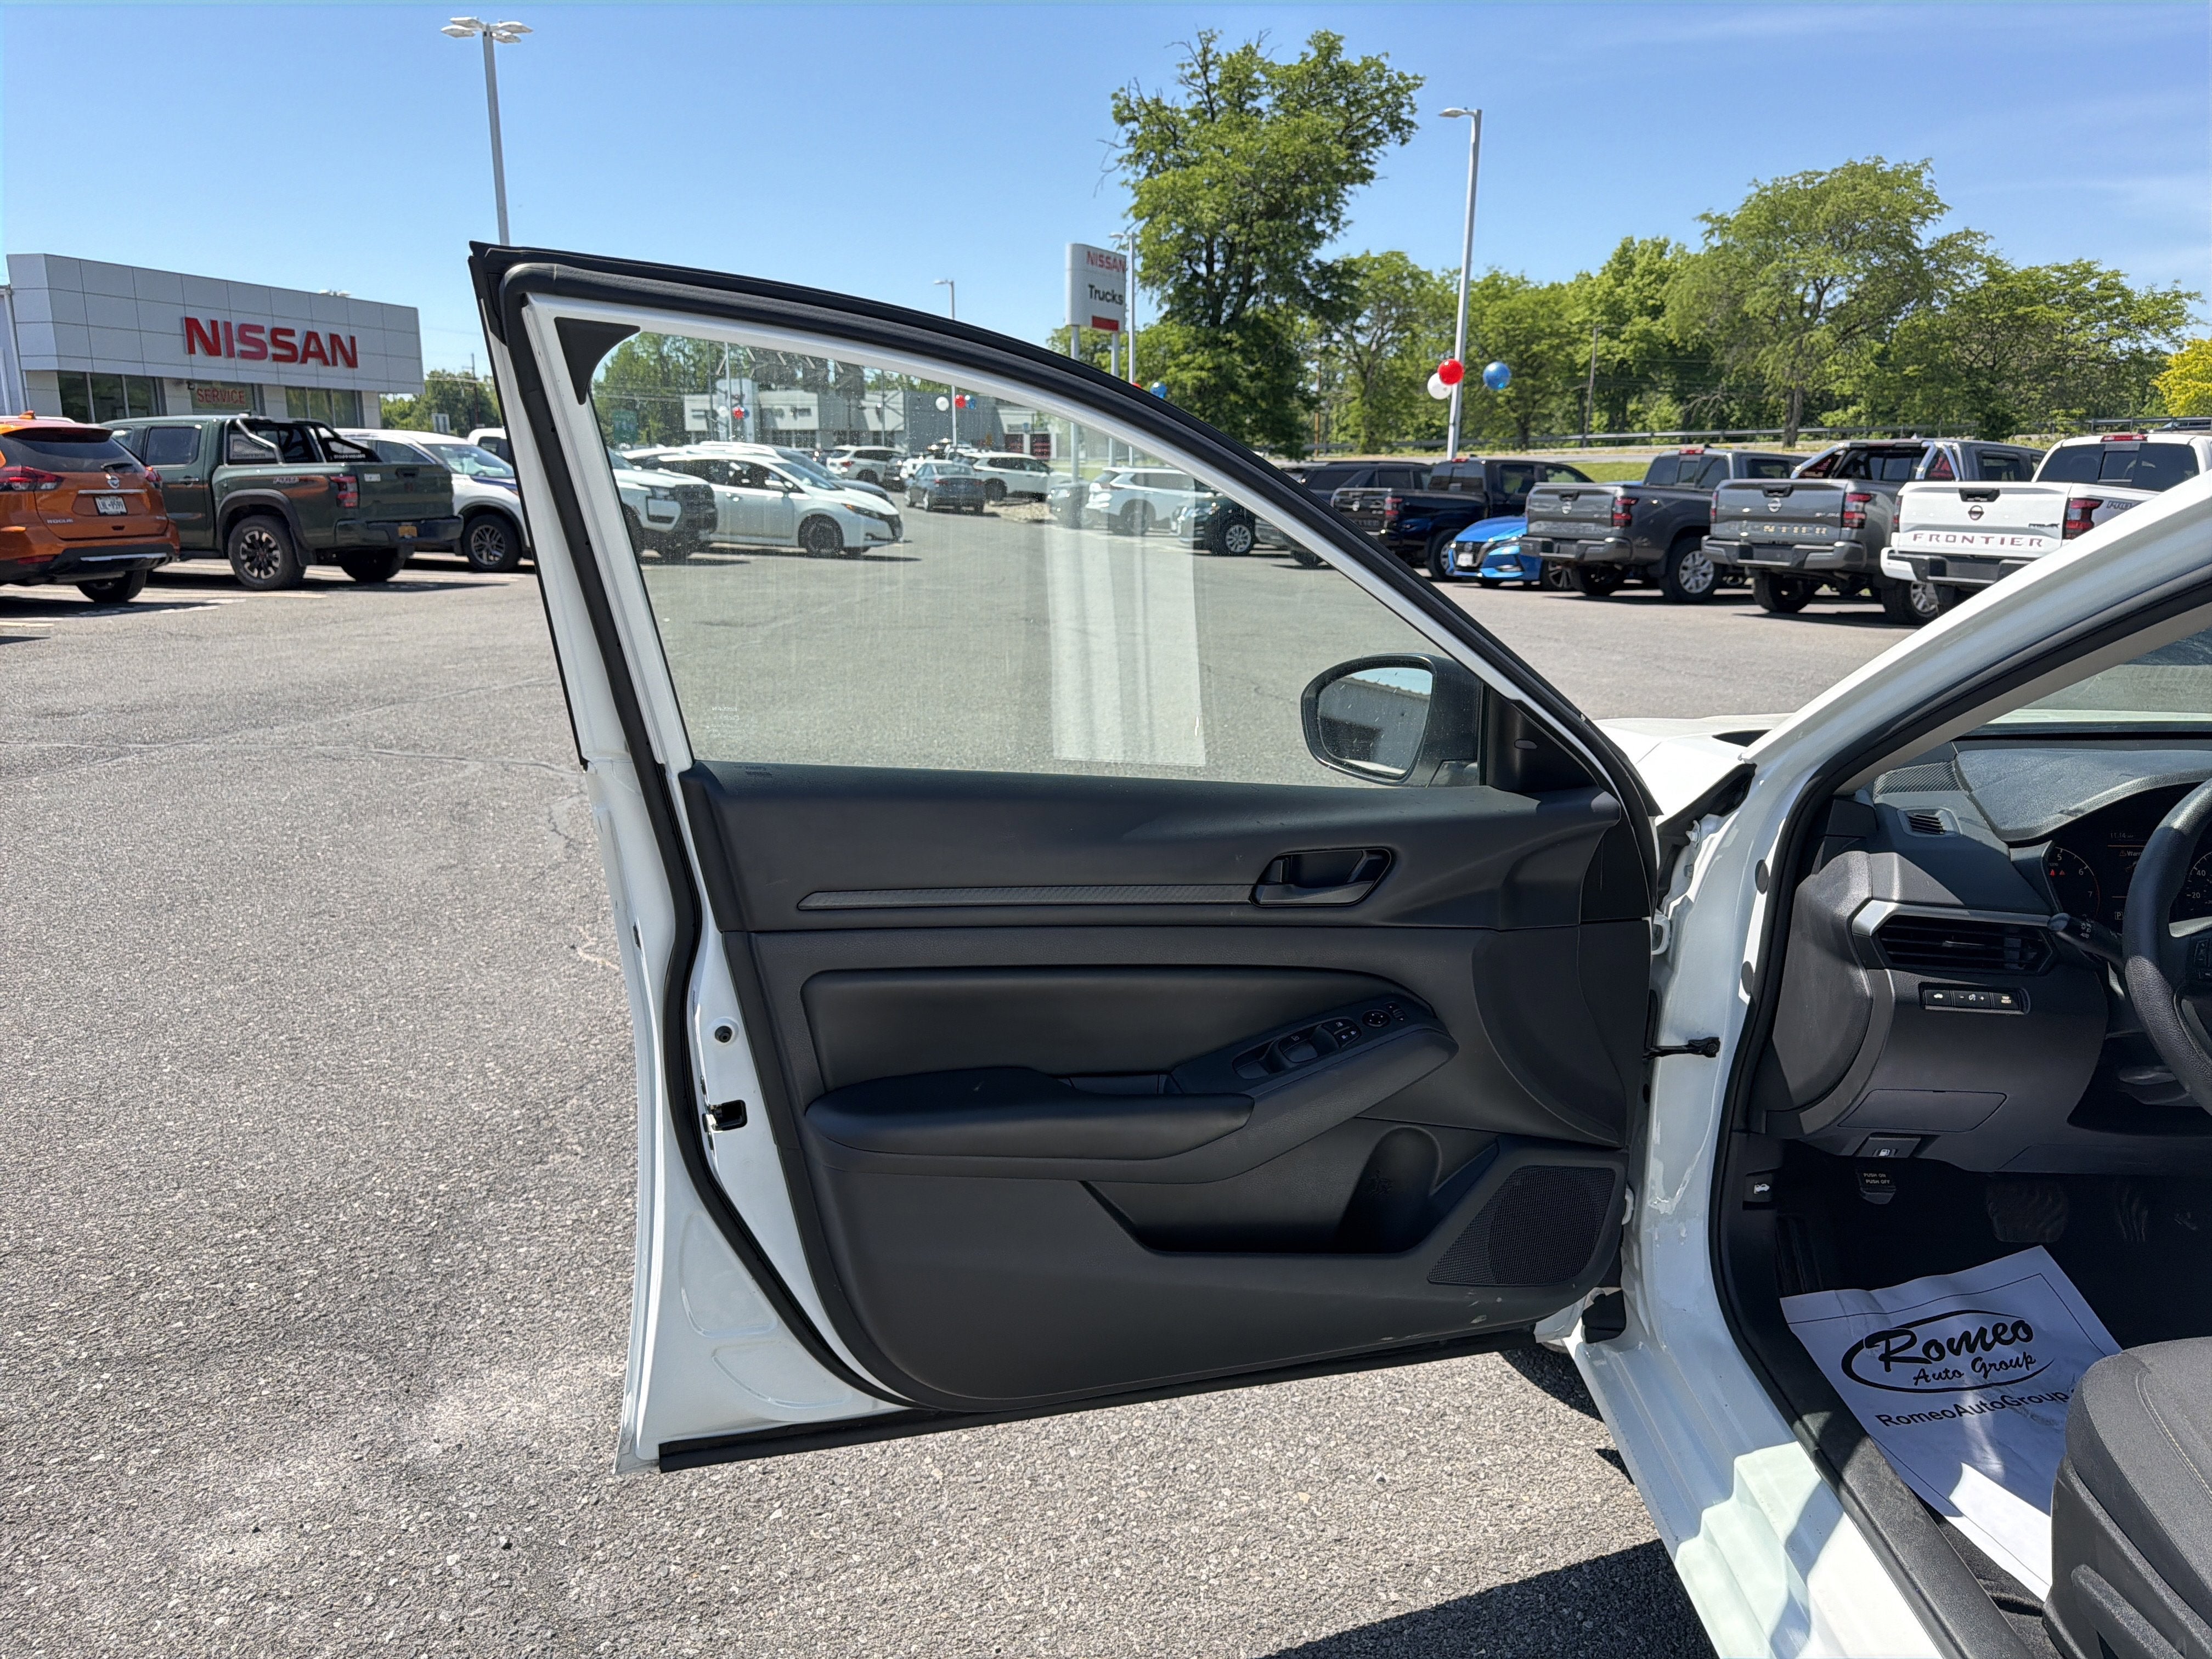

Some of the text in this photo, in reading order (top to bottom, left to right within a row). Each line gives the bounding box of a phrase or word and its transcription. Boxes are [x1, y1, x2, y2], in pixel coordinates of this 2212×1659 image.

[1087, 251, 1126, 273] NISSAN
[1088, 284, 1124, 306] Trucks
[184, 317, 358, 369] NISSAN
[196, 388, 245, 405] SERVICE
[1912, 533, 2044, 548] FRONTIER
[1865, 1319, 2034, 1372] Romeo
[1912, 1351, 2036, 1386] Auto Group
[1875, 1389, 2074, 1427] RomeoAutoGroup
